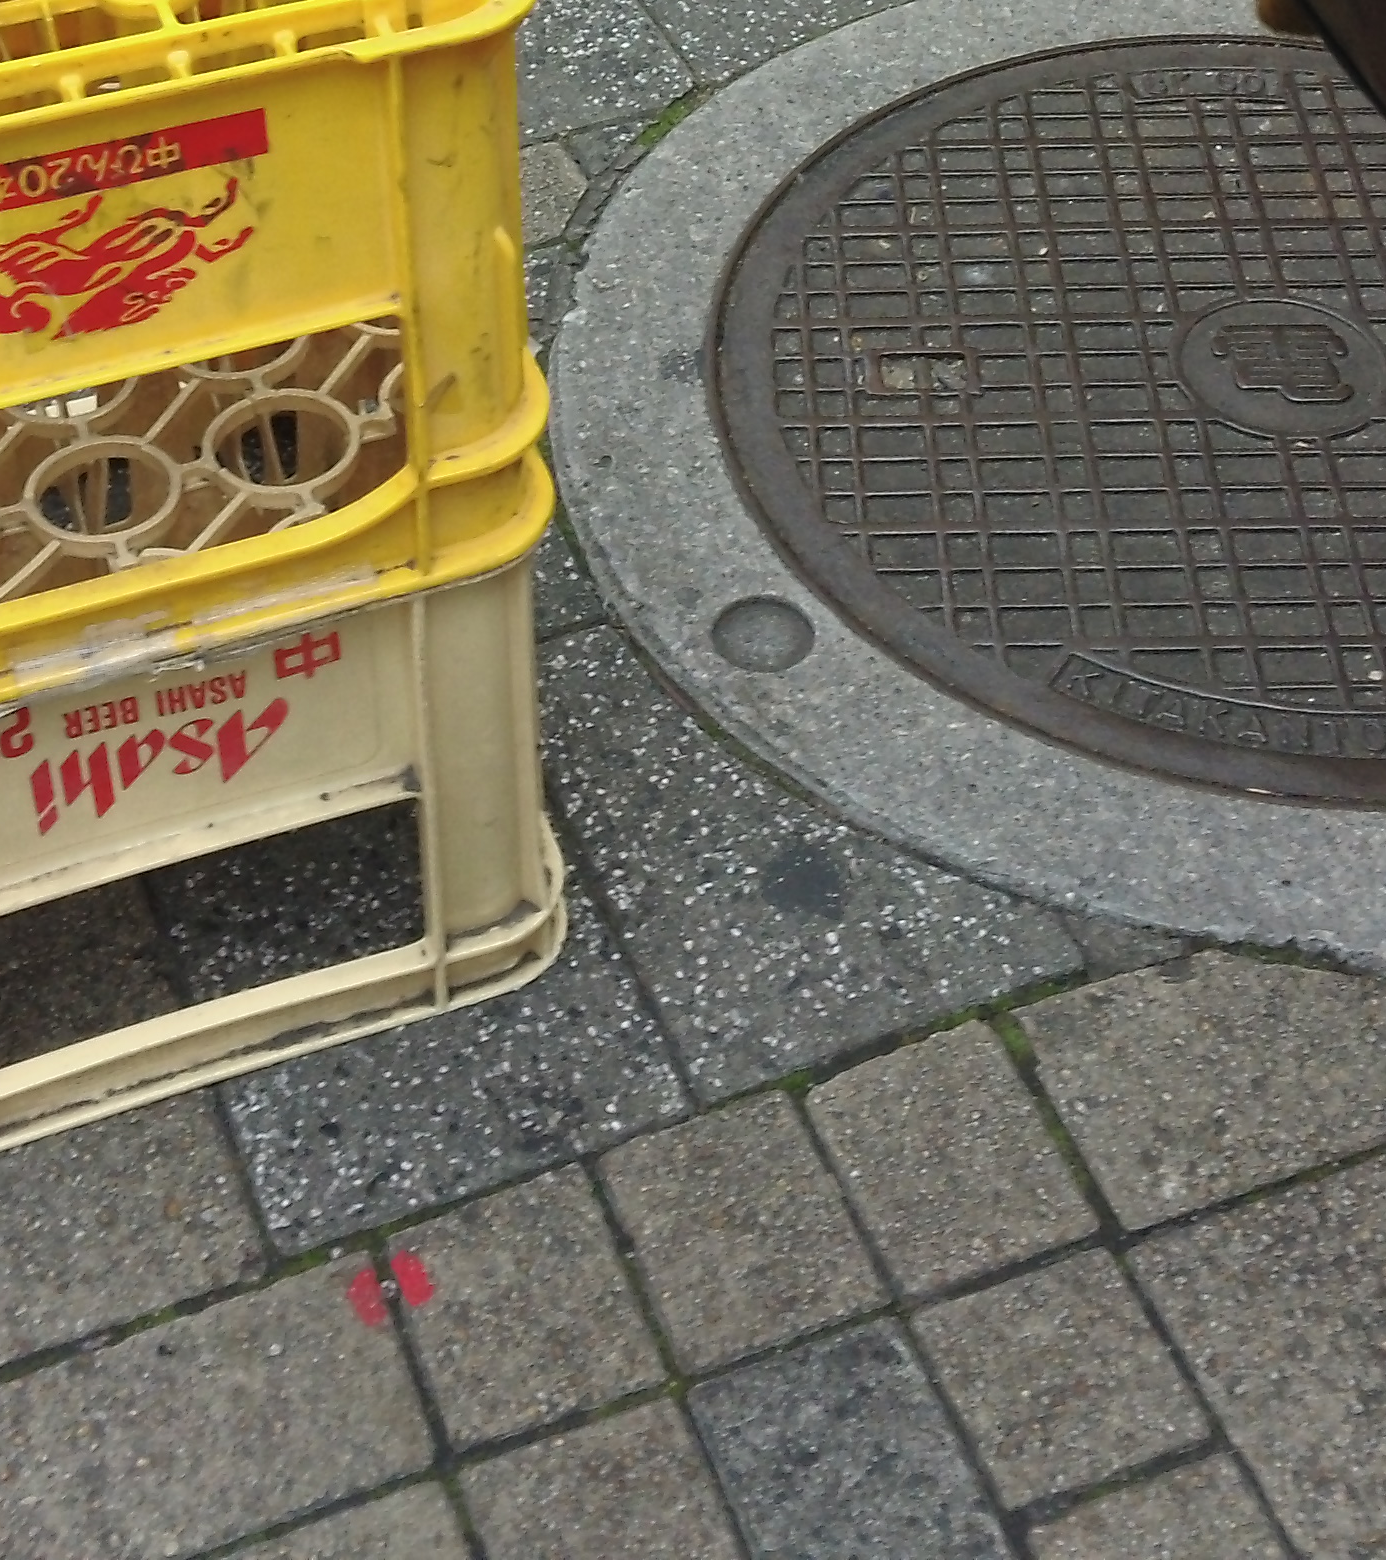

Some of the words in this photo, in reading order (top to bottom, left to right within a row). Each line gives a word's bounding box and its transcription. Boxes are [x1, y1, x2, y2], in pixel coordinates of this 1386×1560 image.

[272, 630, 342, 680] 中
[63, 696, 141, 739] BEER
[155, 670, 247, 717] ASAHI
[29, 696, 289, 837] Asahi
